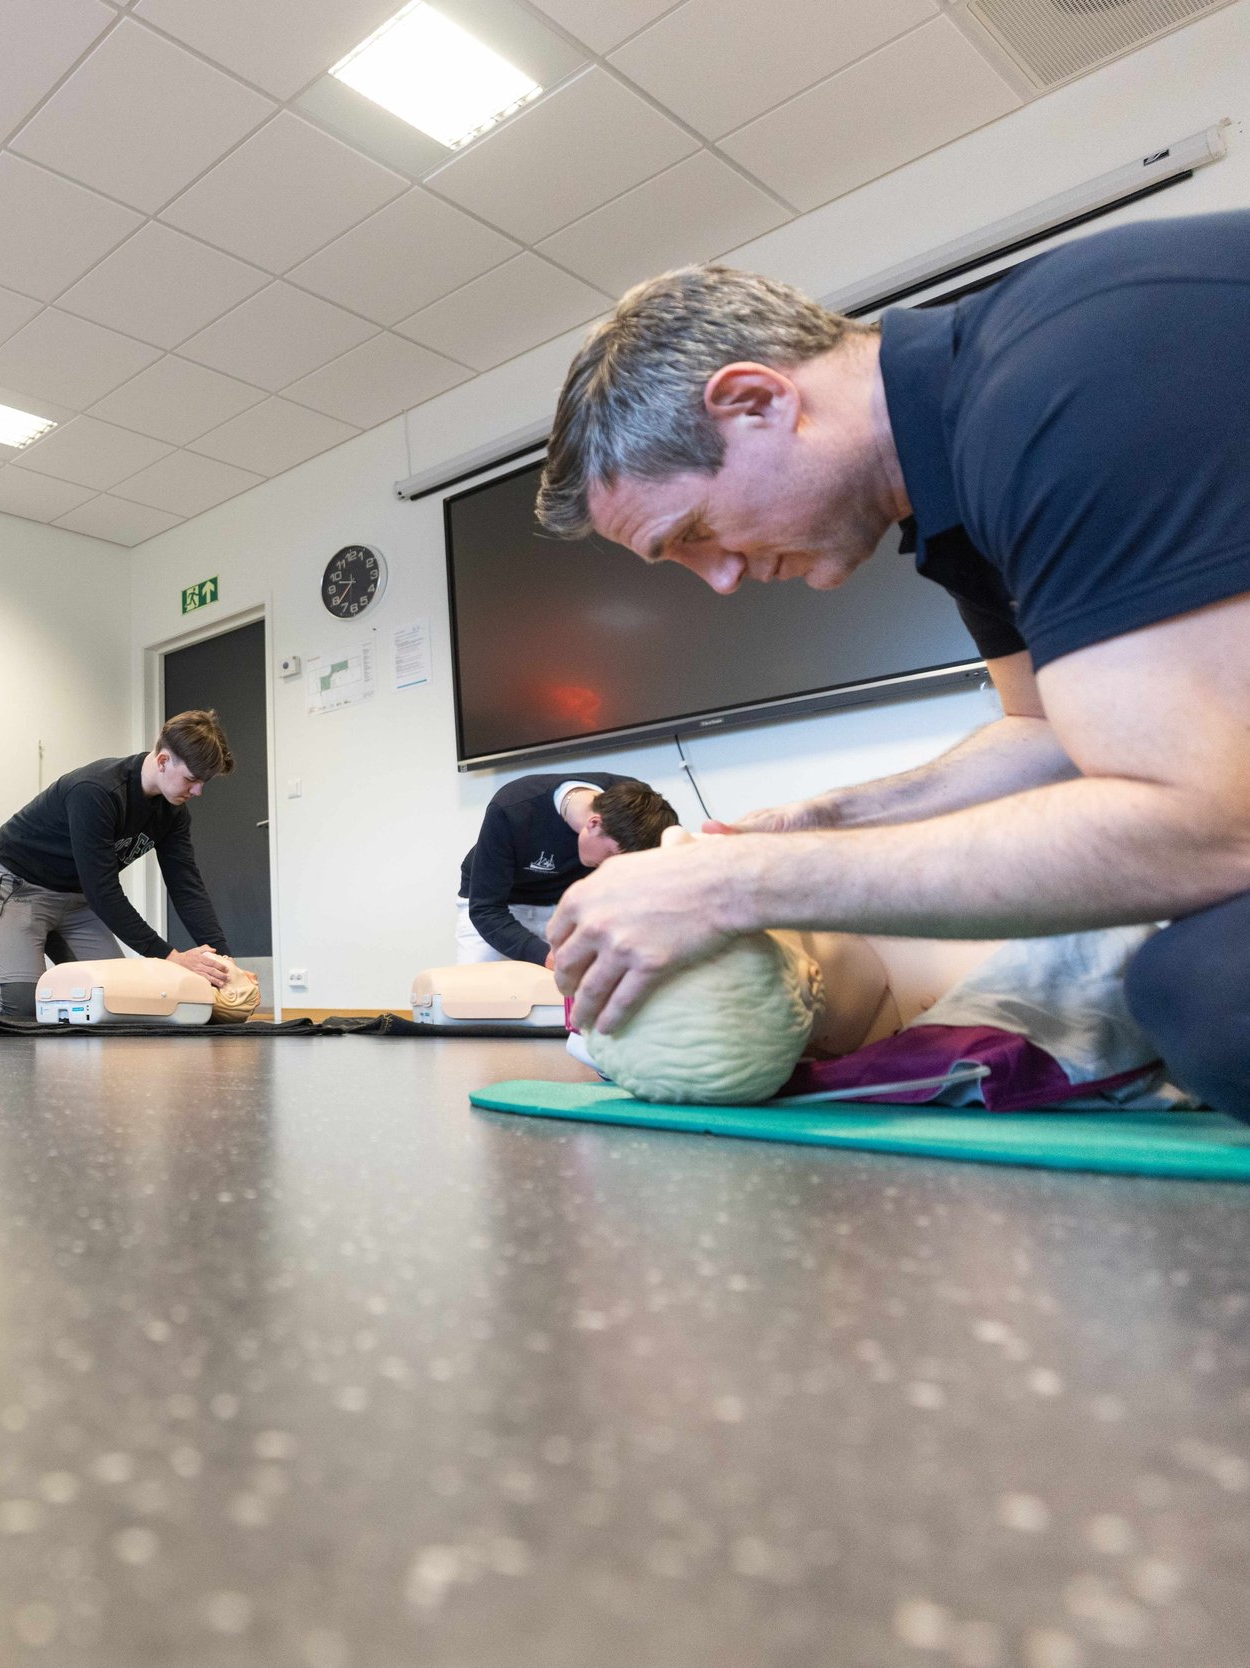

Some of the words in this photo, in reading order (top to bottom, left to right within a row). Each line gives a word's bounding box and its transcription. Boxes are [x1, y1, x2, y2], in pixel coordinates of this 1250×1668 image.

[345, 550, 357, 562] 12
[358, 551, 364, 560] 1
[336, 560, 346, 570] 11
[366, 557, 374, 568] 2
[330, 571, 342, 582] 10
[370, 569, 378, 580] 3
[328, 585, 336, 595] 9
[367, 583, 375, 593] 4
[332, 596, 341, 606] 8
[360, 595, 368, 606] 5
[341, 602, 348, 613] 7
[350, 603, 358, 613] 6
